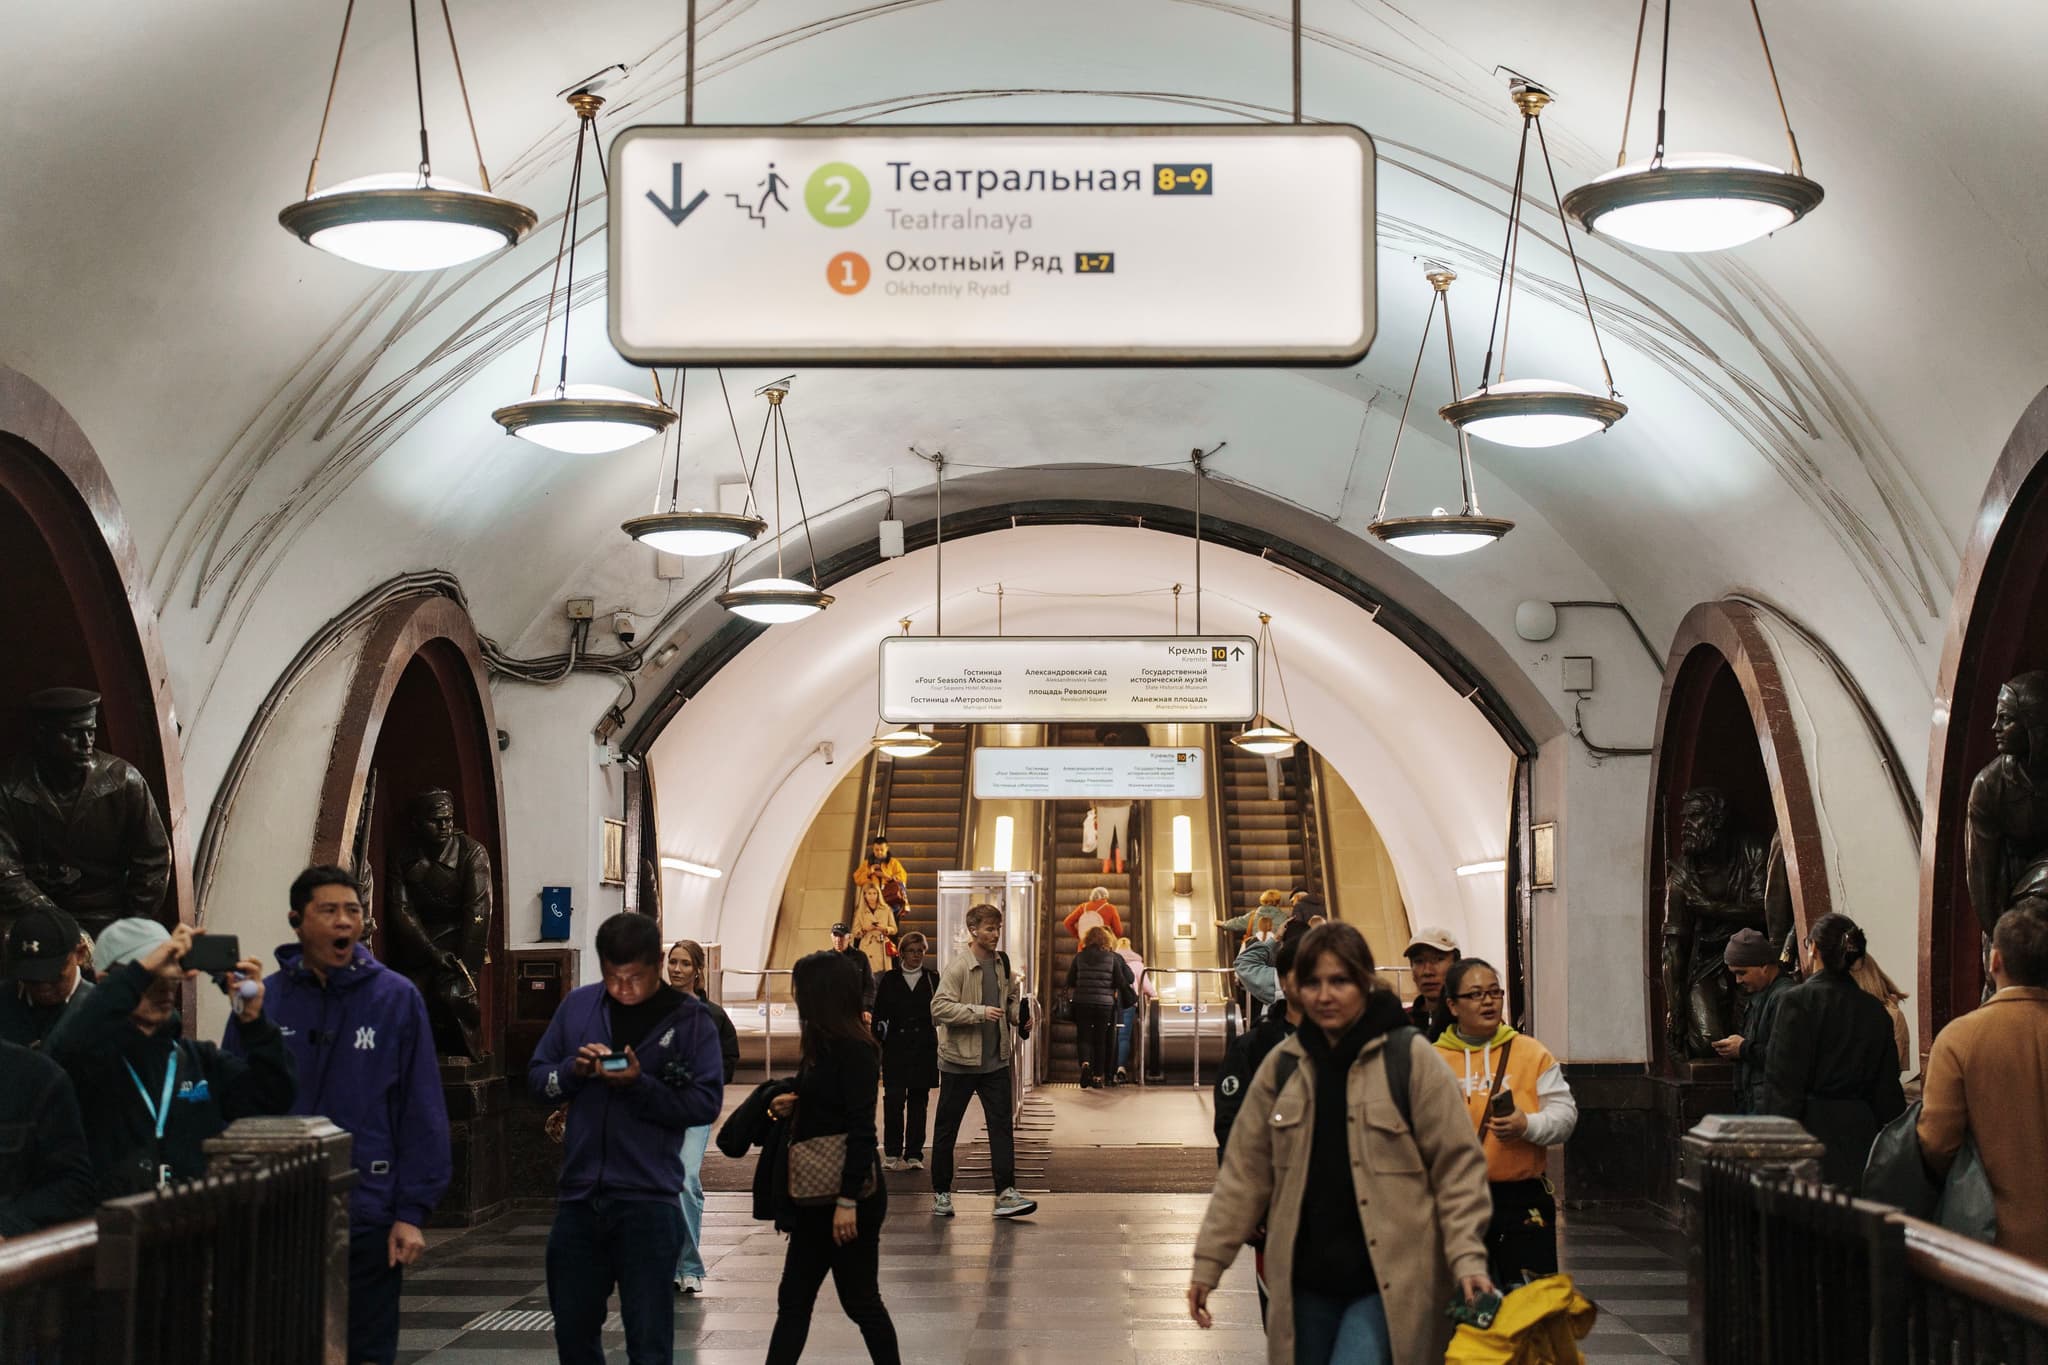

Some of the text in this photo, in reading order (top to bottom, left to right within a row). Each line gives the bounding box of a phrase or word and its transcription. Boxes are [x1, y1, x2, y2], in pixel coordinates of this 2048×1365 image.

[824, 176, 851, 214] 2
[886, 162, 1142, 199] Театральная
[885, 208, 1033, 234] Teatralnaya
[840, 260, 857, 286] 1
[885, 250, 1004, 272] Охотный
[1014, 251, 1063, 274] Ряд
[884, 280, 1011, 298] Okhotniy Ryad
[1168, 646, 1226, 660] Кремль 10
[964, 669, 1002, 677] Гостиница
[1025, 669, 1093, 677] Александровский
[1141, 668, 1208, 677] Государственный
[1130, 677, 1208, 685] исторический музей
[1064, 688, 1107, 696] Революции
[910, 696, 949, 704] Гостиница
[1173, 696, 1208, 704] площадь
